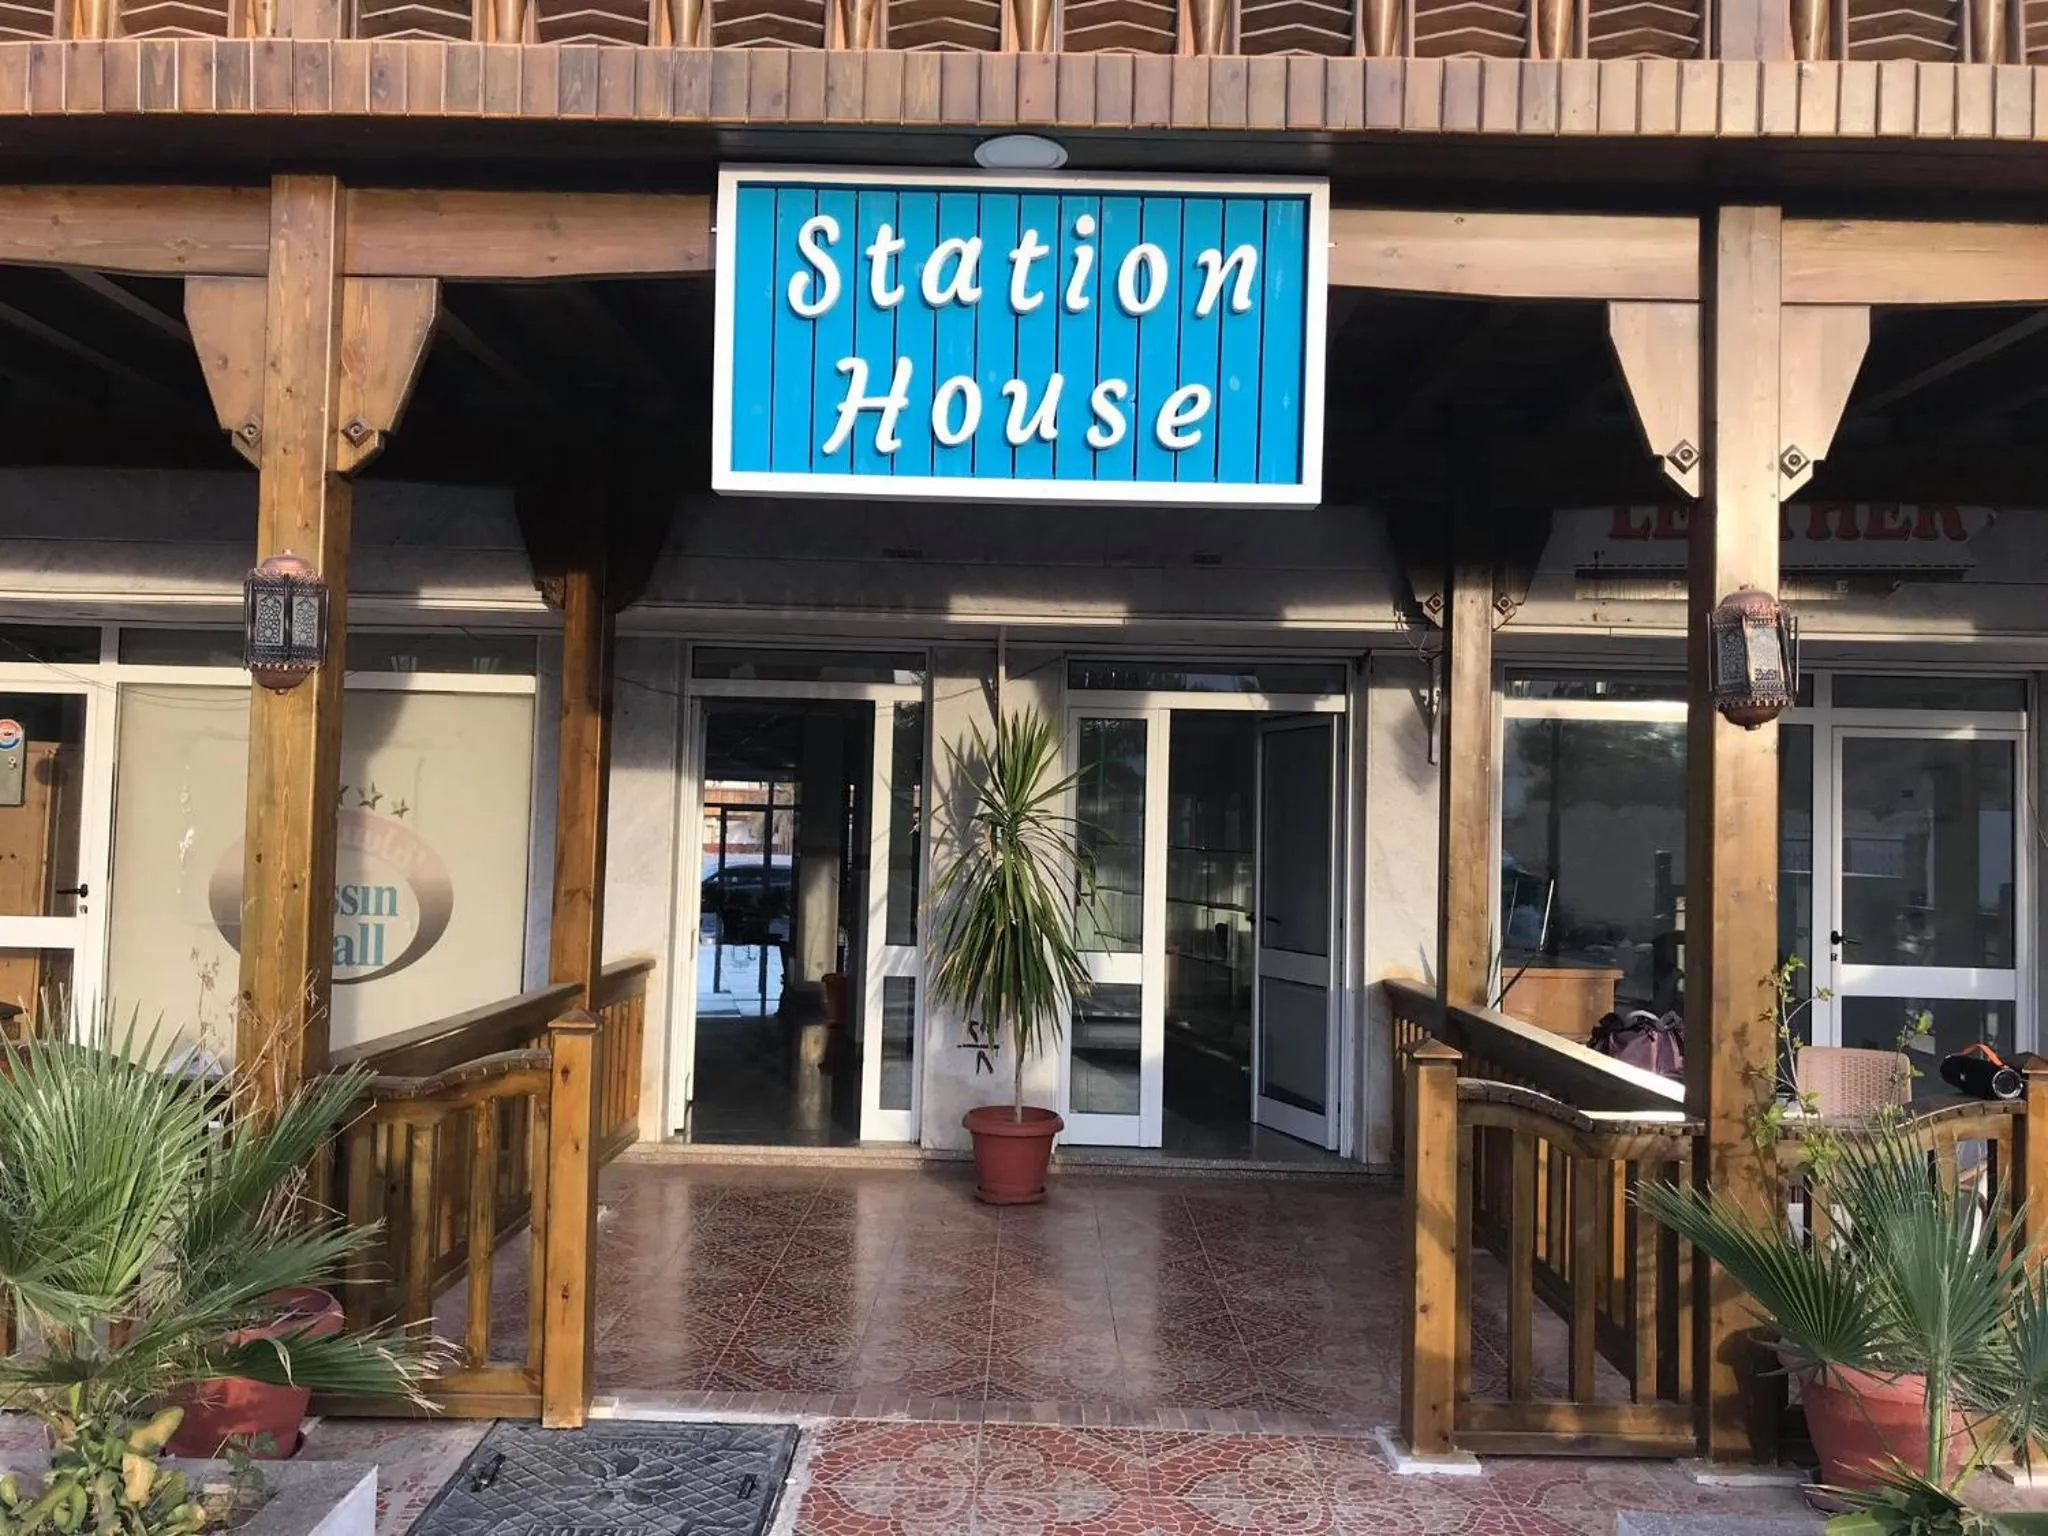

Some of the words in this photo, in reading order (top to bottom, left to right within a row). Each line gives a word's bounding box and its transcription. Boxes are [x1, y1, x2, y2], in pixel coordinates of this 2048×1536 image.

[787, 214, 1259, 318] Station
[822, 356, 1211, 455] House
[1608, 502, 1968, 541] LEHER
[332, 923, 385, 966] all
